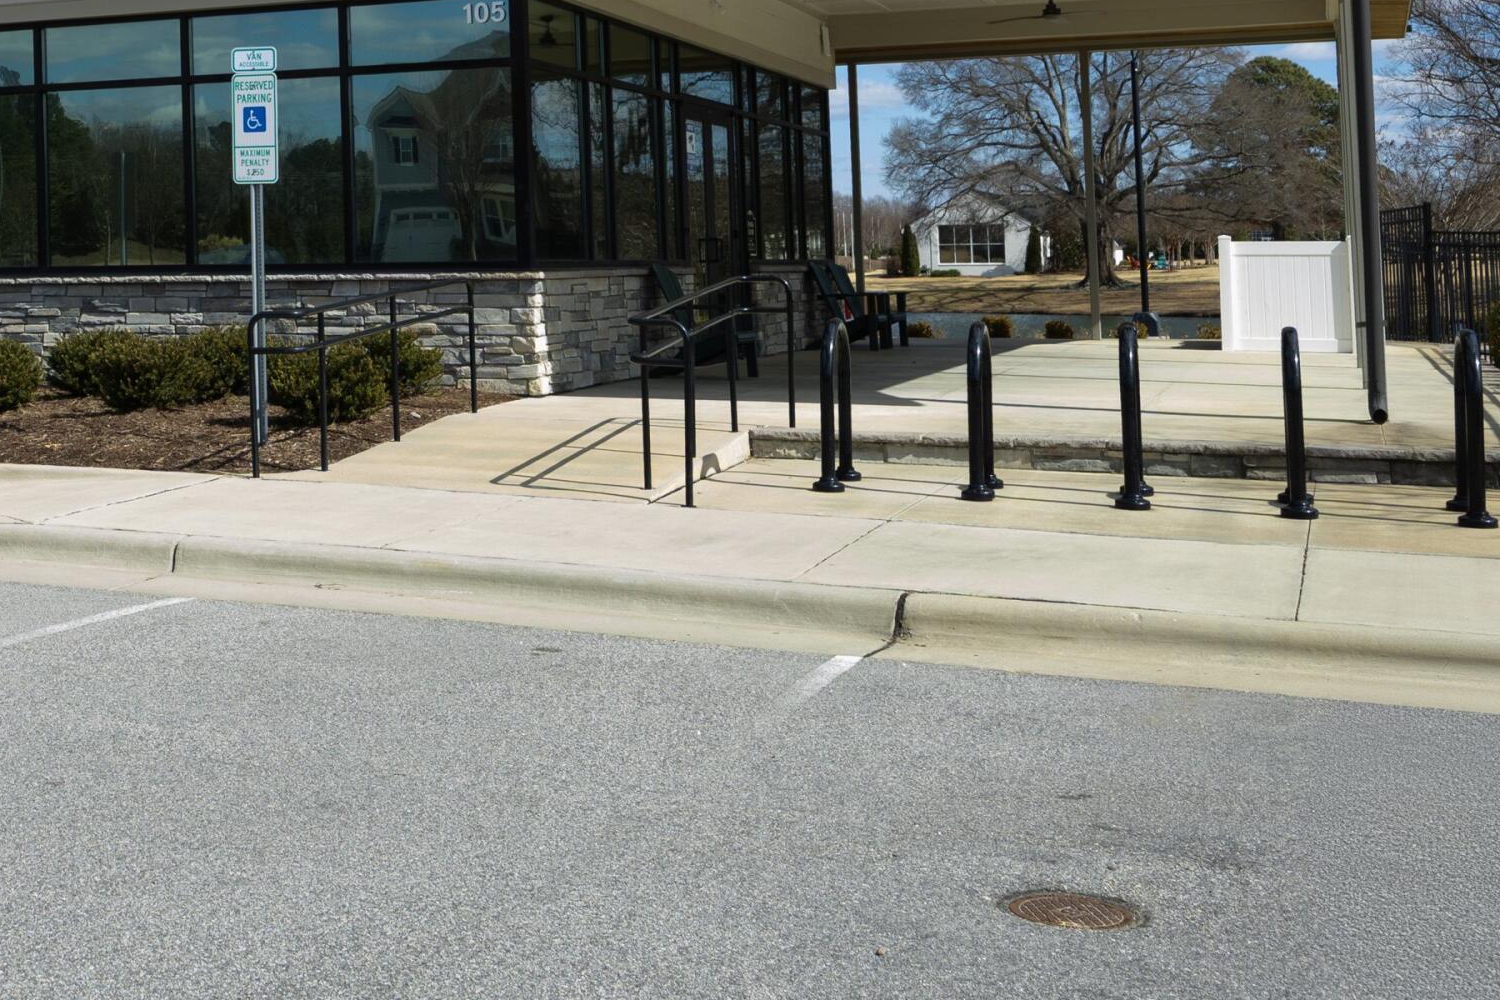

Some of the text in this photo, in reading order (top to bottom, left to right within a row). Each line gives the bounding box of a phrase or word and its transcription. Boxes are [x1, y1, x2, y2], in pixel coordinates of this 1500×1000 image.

[462, 1, 506, 24] 105
[246, 53, 262, 61] VAN
[234, 80, 274, 91] RESERVED
[236, 93, 272, 104] PARKING
[240, 149, 271, 158] MAXIMUM
[240, 158, 270, 167] PENALTY
